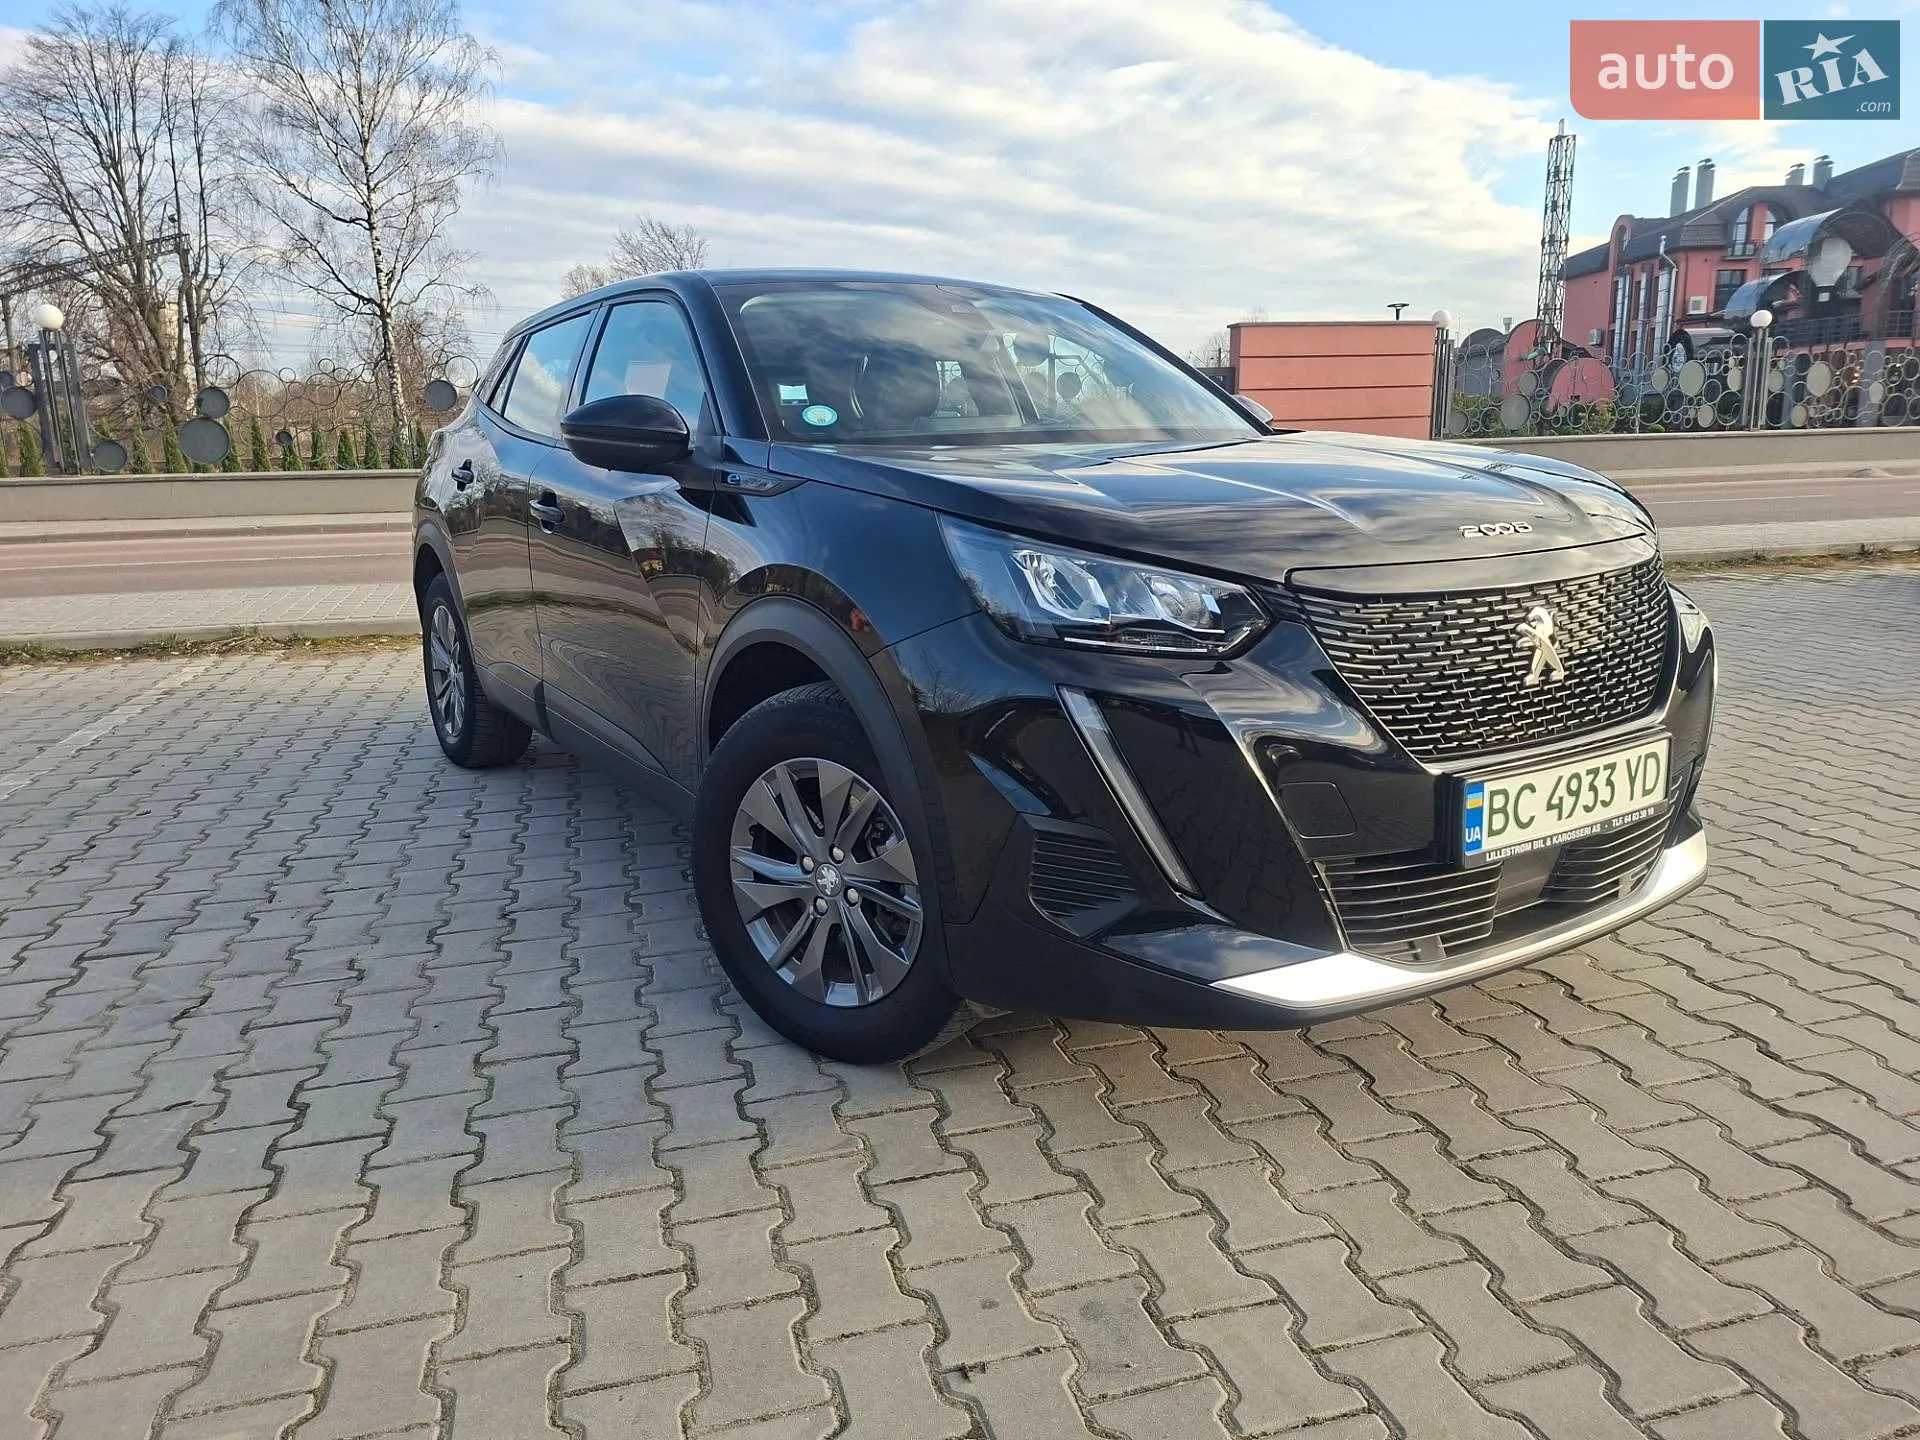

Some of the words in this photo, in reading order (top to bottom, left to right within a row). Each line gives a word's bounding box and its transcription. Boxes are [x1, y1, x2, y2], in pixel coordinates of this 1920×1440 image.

[1458, 521, 1533, 538] 2008
[1487, 782, 1537, 838] BC
[1545, 761, 1617, 822] 4933
[1625, 751, 1661, 802] YD
[1465, 826, 1481, 843] UA
[1533, 839, 1545, 850] BIL
[1552, 826, 1591, 845] KAROSSERI
